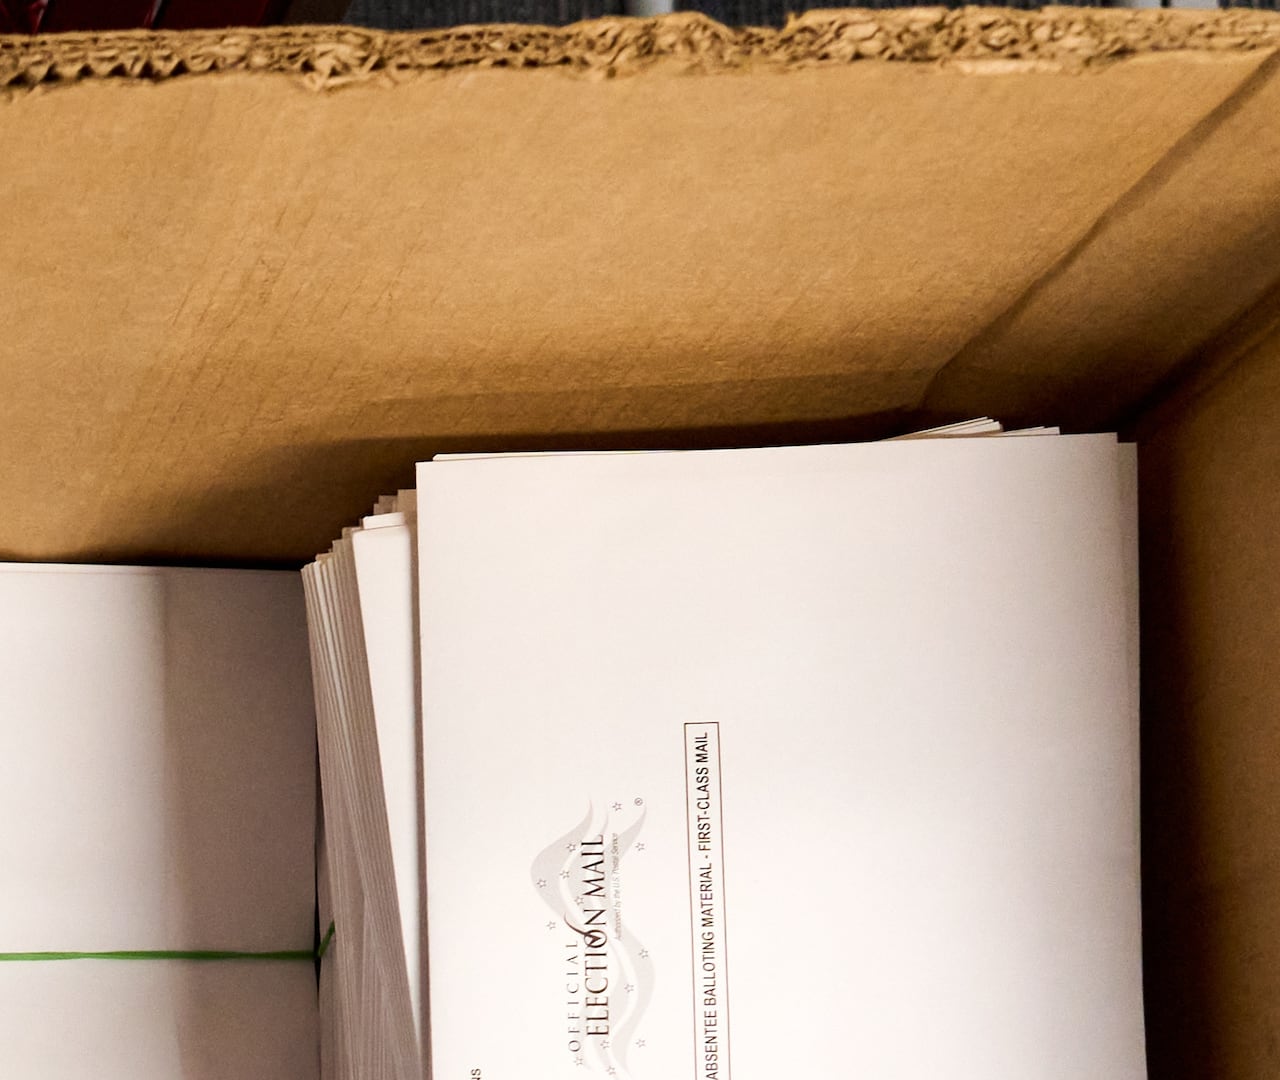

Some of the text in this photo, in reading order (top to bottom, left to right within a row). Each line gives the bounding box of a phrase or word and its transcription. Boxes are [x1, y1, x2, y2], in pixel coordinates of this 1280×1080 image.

[694, 732, 708, 763] MAIL
[695, 766, 711, 851] FIRST-CLASS
[698, 862, 714, 927] MATERIAL
[580, 833, 610, 1037] ELECTION MAIL
[701, 931, 716, 1006] BALLOTING
[565, 939, 582, 1053] OFFICIAL
[703, 1010, 718, 1080] ABSENTEE
